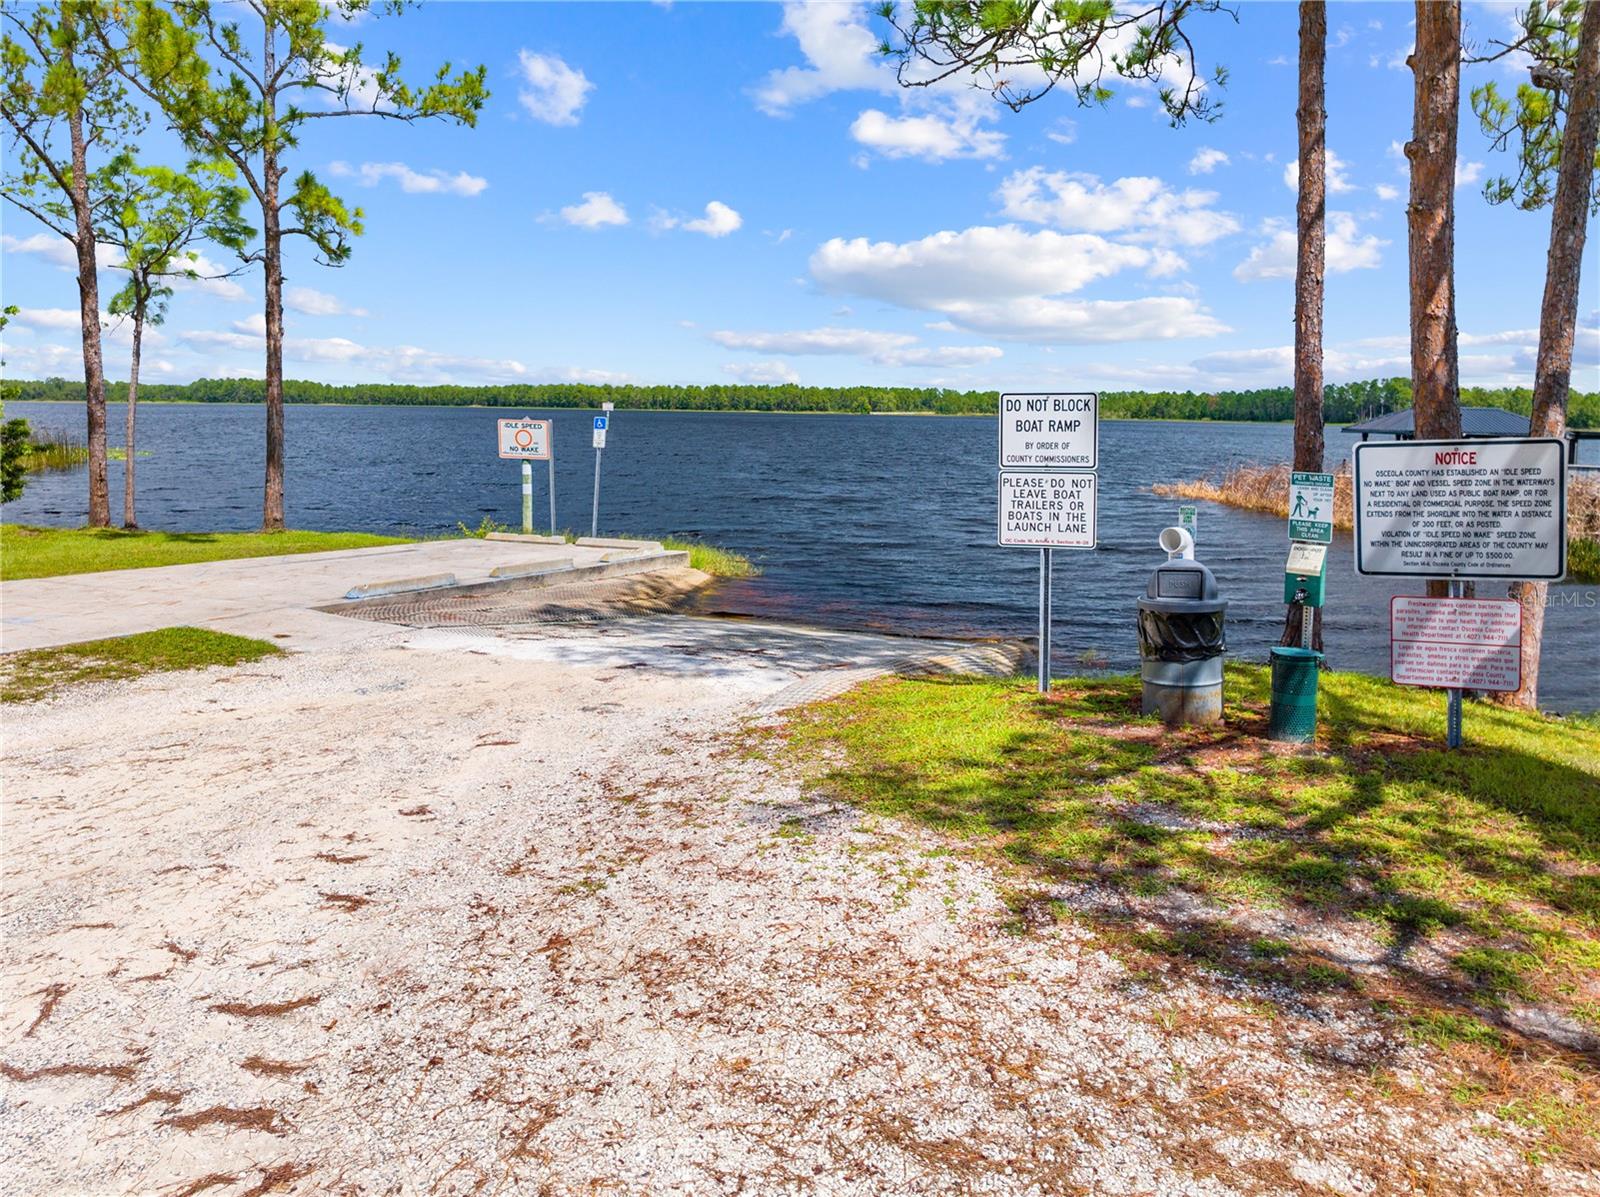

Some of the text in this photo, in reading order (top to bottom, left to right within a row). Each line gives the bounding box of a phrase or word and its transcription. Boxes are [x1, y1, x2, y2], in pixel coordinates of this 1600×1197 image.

[1006, 399, 1091, 412] DO NOT BLOCK
[1016, 420, 1080, 432] BOAT RAMP
[1435, 452, 1476, 465] NOTICE
[1003, 478, 1092, 488] PLEASE DO NOT
[1013, 490, 1080, 499] LEAVE BOAT
[1012, 500, 1084, 510] TRAILERS OR
[1008, 511, 1086, 522] BOATS IN THE
[1007, 523, 1086, 533] LAUNCH LANE
